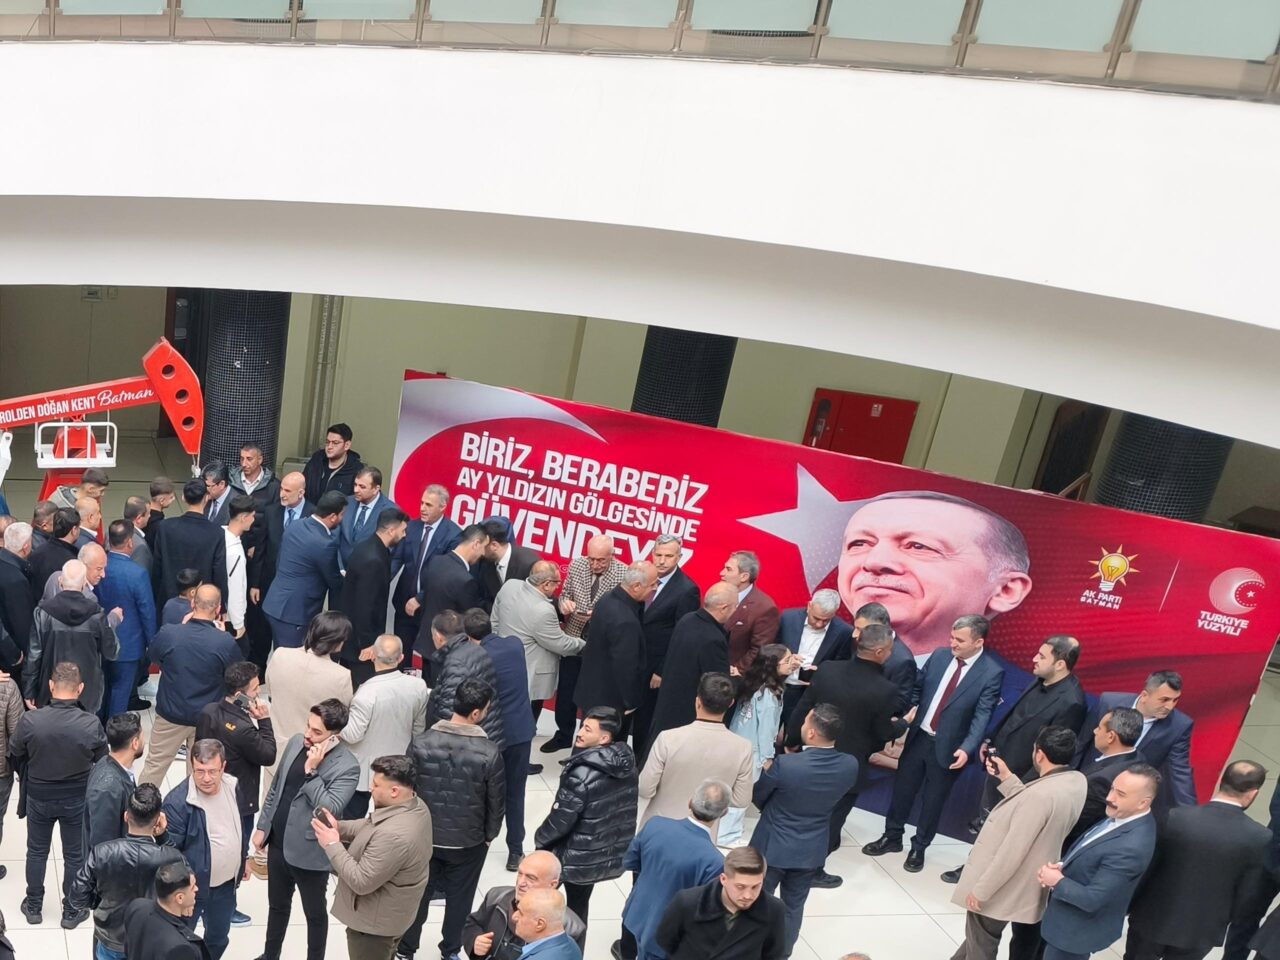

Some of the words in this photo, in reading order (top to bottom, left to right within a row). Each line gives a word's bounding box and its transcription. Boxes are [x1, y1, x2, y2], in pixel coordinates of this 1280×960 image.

[37, 400, 70, 417] DOĞAN
[71, 395, 96, 412] KENT
[97, 389, 154, 406] Batman
[456, 466, 484, 490] AY
[486, 472, 567, 511] YILDIZIN
[569, 491, 701, 542] GÖLGESİNDE
[460, 430, 535, 479] BİRİZ,
[542, 449, 709, 514] BERABERİZ
[450, 492, 694, 568] GÜVENDEY
[1082, 589, 1096, 598] AK
